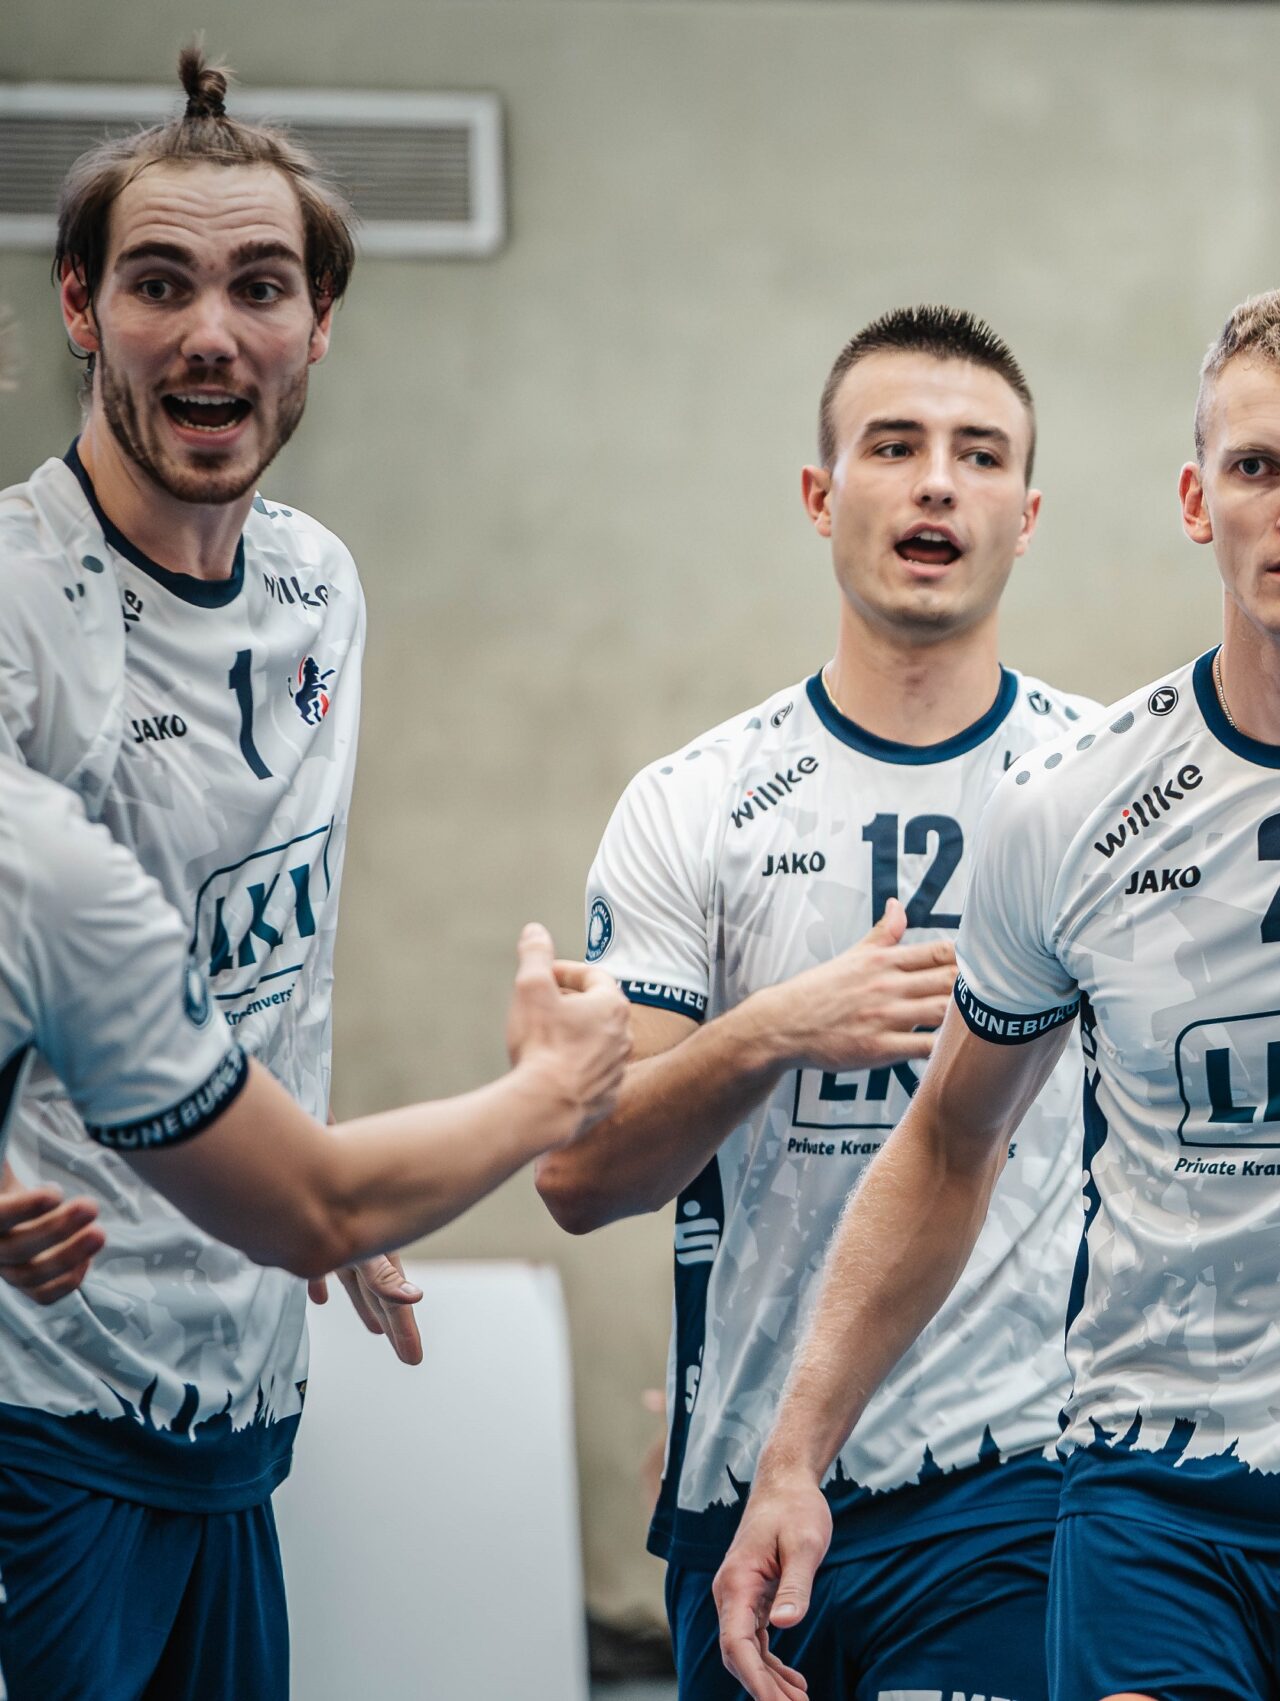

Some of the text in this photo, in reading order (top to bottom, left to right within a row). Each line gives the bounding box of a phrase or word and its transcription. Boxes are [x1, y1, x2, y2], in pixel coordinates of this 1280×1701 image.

[131, 714, 188, 743] JAKO
[229, 648, 273, 780] 1
[731, 756, 819, 829] willke
[1094, 764, 1203, 858] willke
[762, 850, 826, 877] JAKO
[862, 813, 964, 929] 12
[1124, 865, 1202, 895] JAKO
[1174, 1157, 1236, 1176] Private
